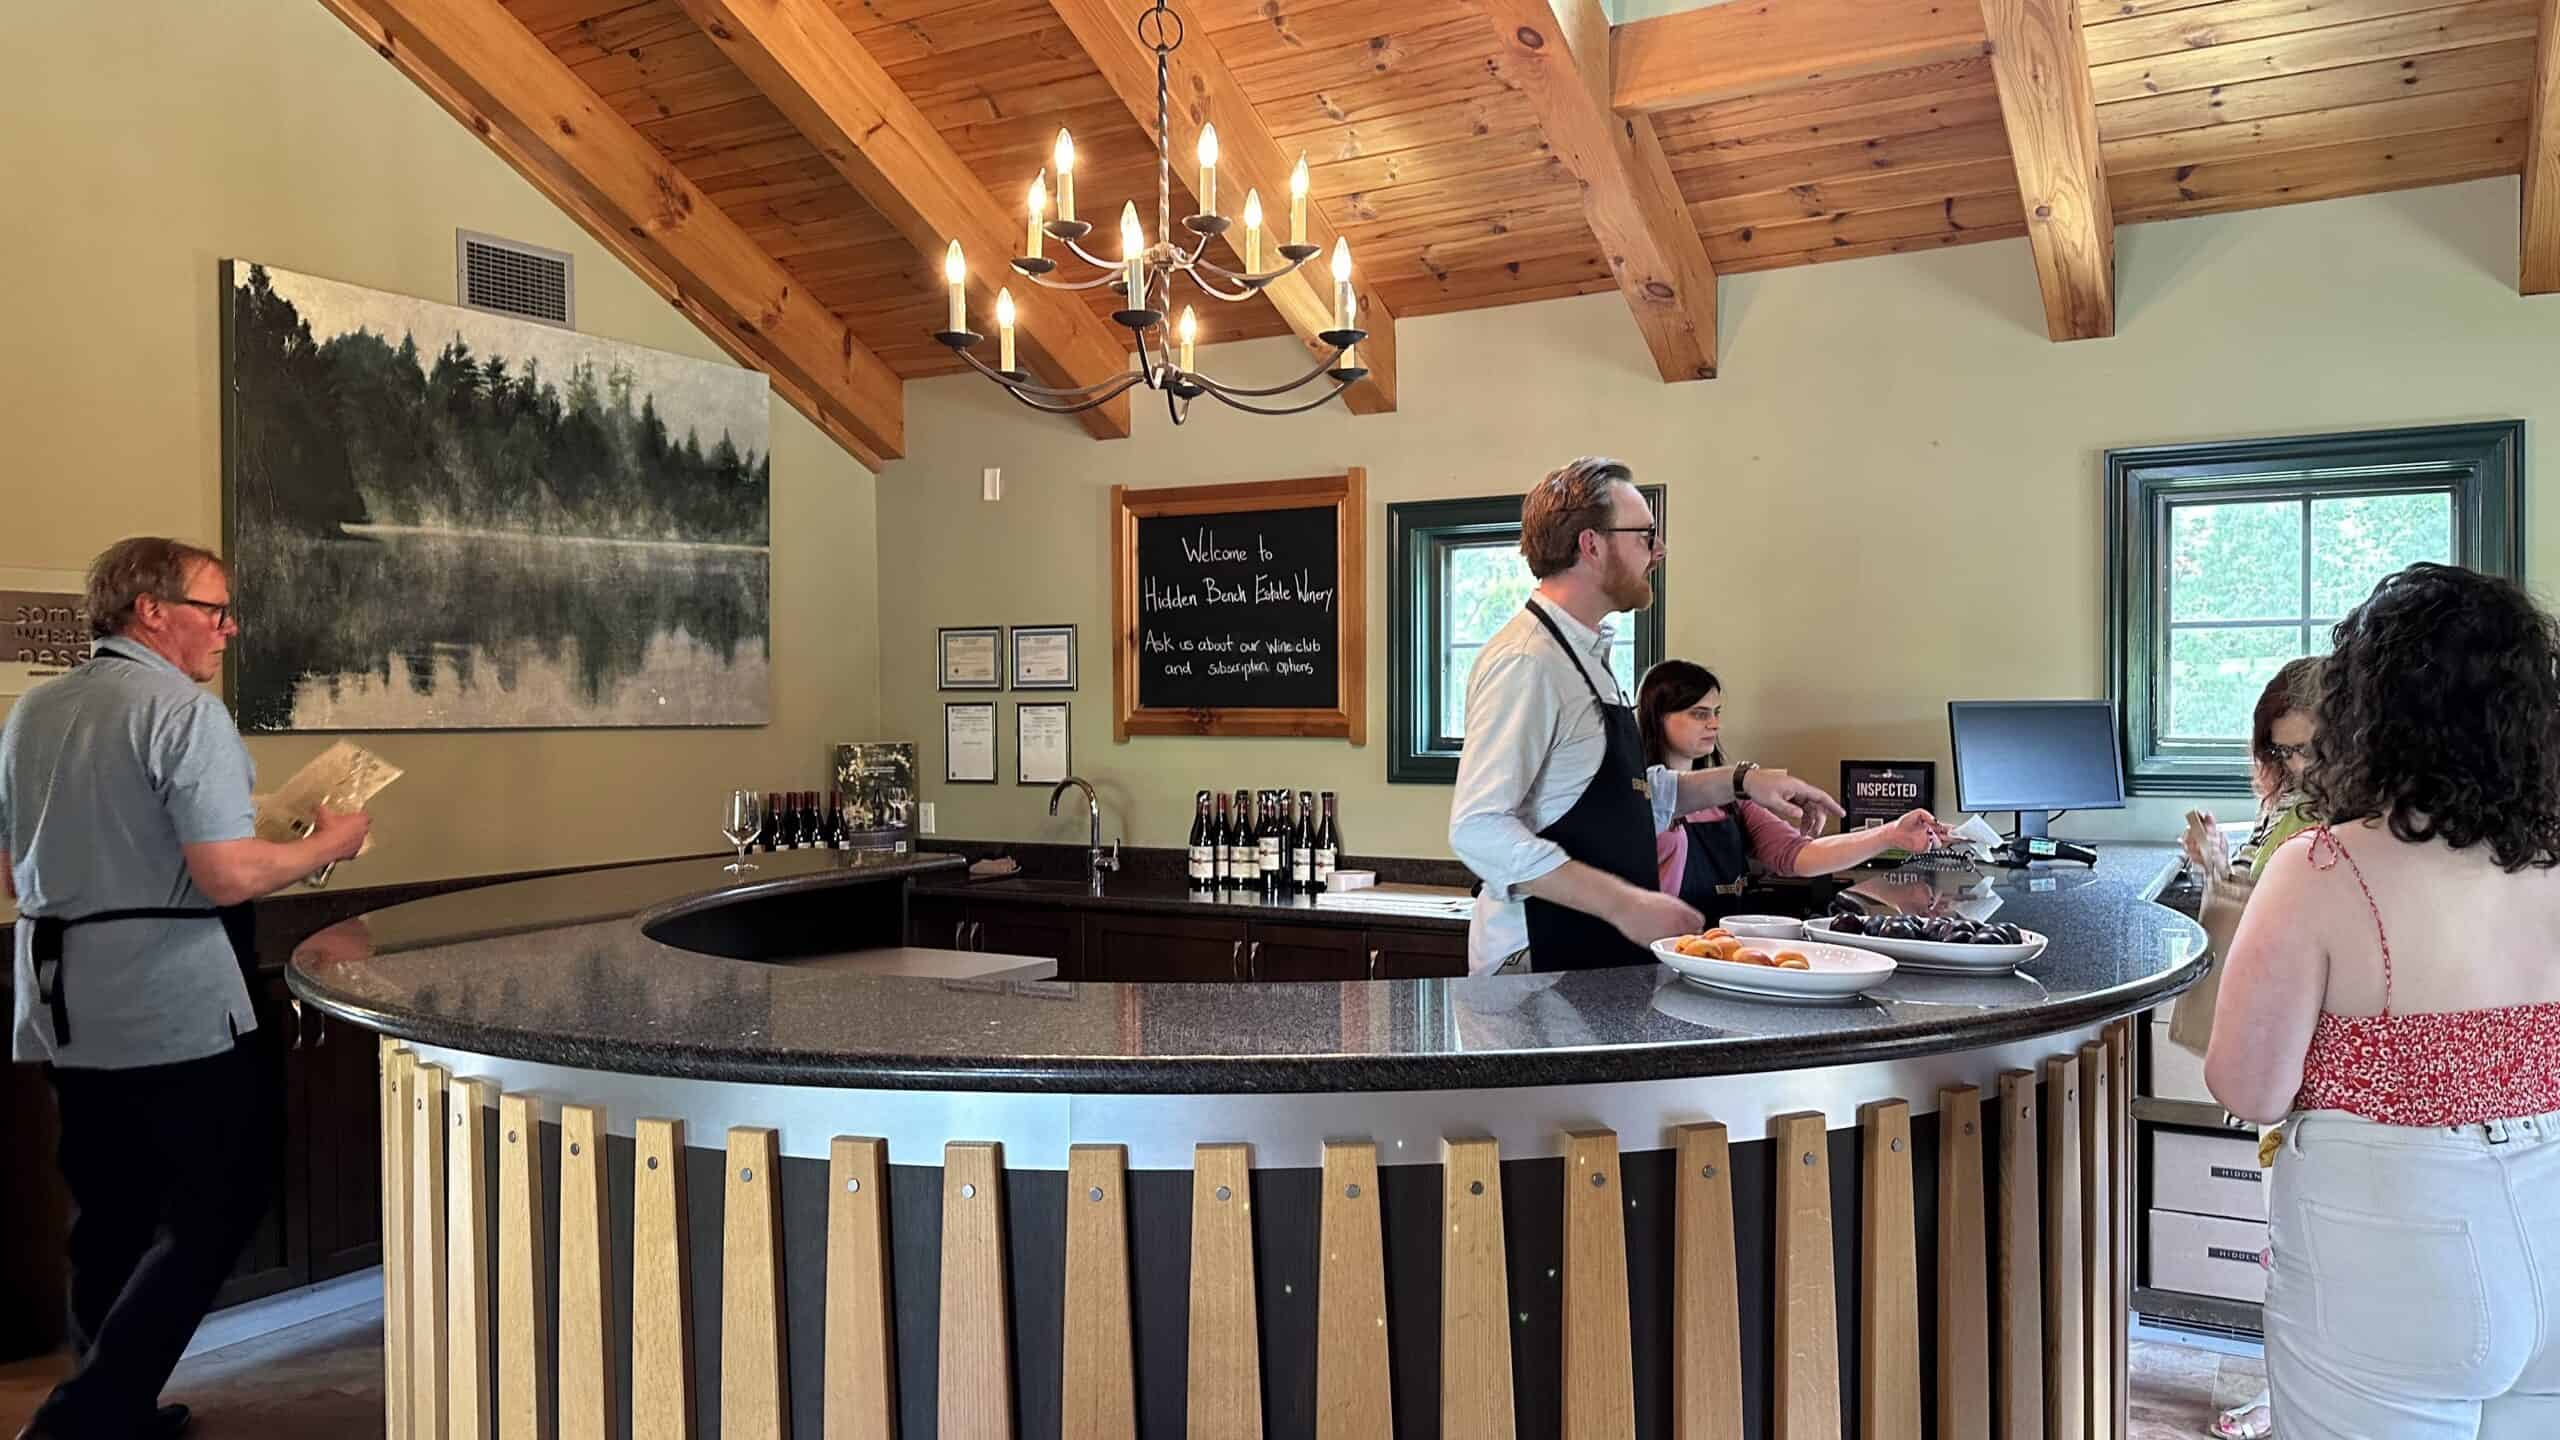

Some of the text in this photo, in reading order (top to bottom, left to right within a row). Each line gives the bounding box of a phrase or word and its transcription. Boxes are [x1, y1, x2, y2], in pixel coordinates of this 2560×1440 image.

[1181, 526, 1273, 563] Welcome to
[1144, 567, 1334, 613] Hidden Bench Estate Winery
[1144, 628, 1175, 654] Ask
[1178, 639, 1194, 651] us
[1198, 633, 1234, 653] about
[1239, 639, 1261, 653] our
[1295, 637, 1321, 653] club
[1164, 660, 1193, 676] and
[1276, 656, 1314, 676] options
[1856, 782, 1917, 798] INSPECTED
[2221, 1167, 2261, 1180] HIDDEN
